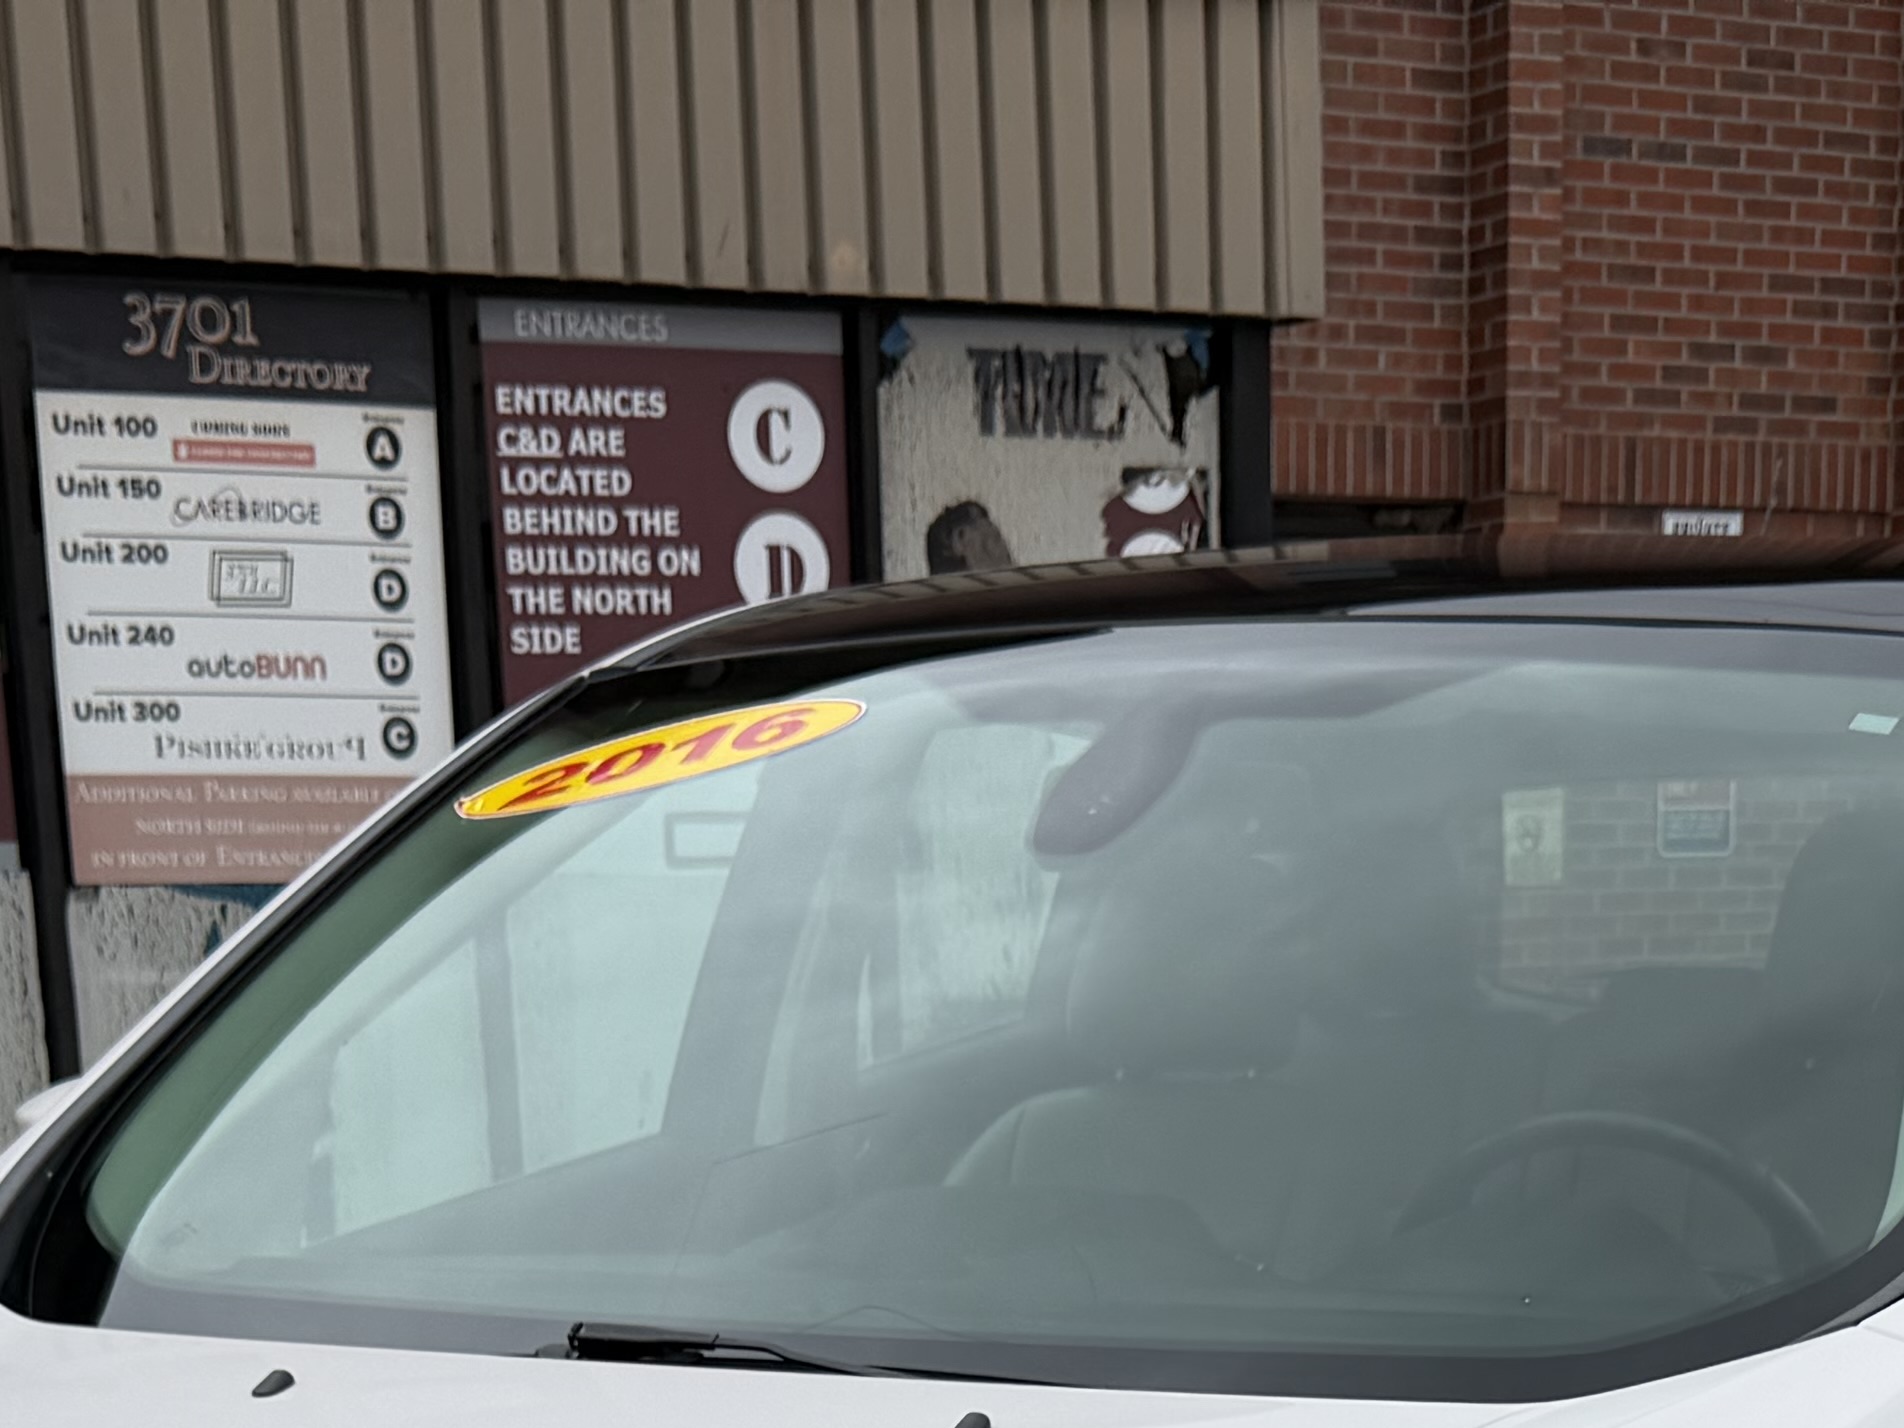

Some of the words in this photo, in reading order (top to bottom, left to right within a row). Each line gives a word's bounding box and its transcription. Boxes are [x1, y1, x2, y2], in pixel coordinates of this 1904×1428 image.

[122, 291, 260, 359] 3701
[514, 309, 668, 342] ENTRANCES
[186, 345, 372, 392] DIRECTORY
[495, 384, 667, 418] ENTRANCES
[52, 413, 105, 437] Unit
[114, 415, 158, 438] 100
[755, 407, 793, 467] C
[497, 427, 563, 457] C&D
[569, 429, 625, 457] ARE
[56, 475, 110, 498] Unit
[118, 477, 162, 499] 150
[500, 467, 632, 496] LOCATED
[503, 506, 617, 536] BEHIND
[624, 509, 680, 537] THE
[61, 541, 113, 564] Unit
[121, 542, 169, 565] 200
[505, 547, 652, 576] BUILDING
[658, 548, 701, 577] ON
[764, 543, 807, 600] D
[508, 586, 565, 614] THE
[572, 586, 673, 616] NORTH
[68, 624, 120, 646] Unit
[127, 624, 175, 647] 240
[510, 625, 582, 655] SIDE
[74, 702, 126, 722] Unit
[133, 702, 181, 723] 300
[497, 707, 817, 812] 2016
